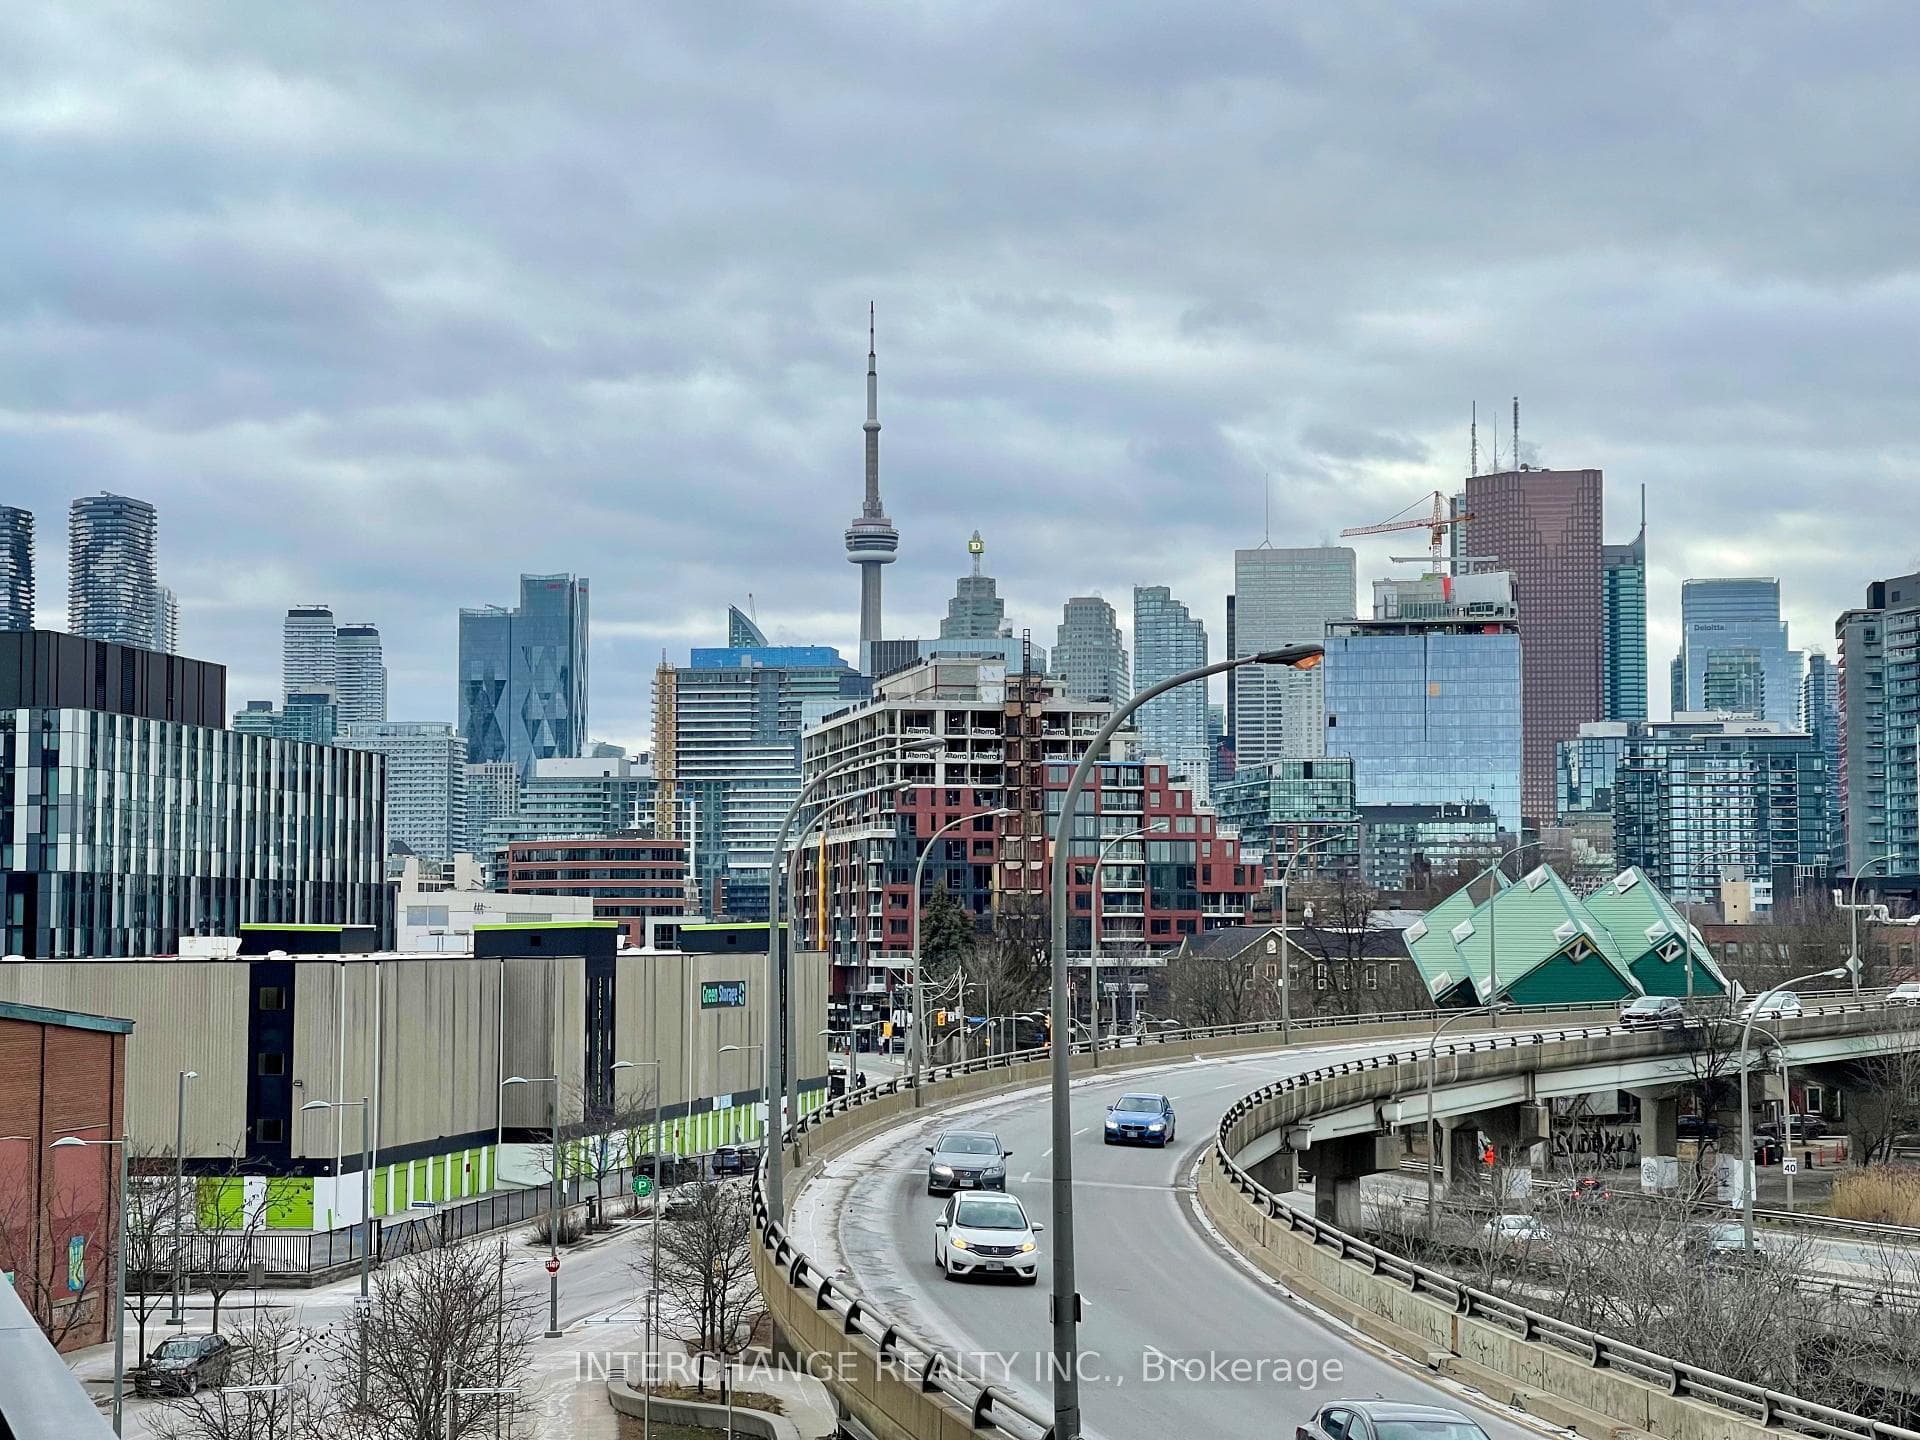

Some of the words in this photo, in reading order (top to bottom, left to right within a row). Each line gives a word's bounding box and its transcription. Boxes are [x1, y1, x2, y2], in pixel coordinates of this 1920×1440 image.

[703, 985, 718, 1003] Green
[719, 984, 738, 1006] Storage
[1784, 1164, 1796, 1172] 40
